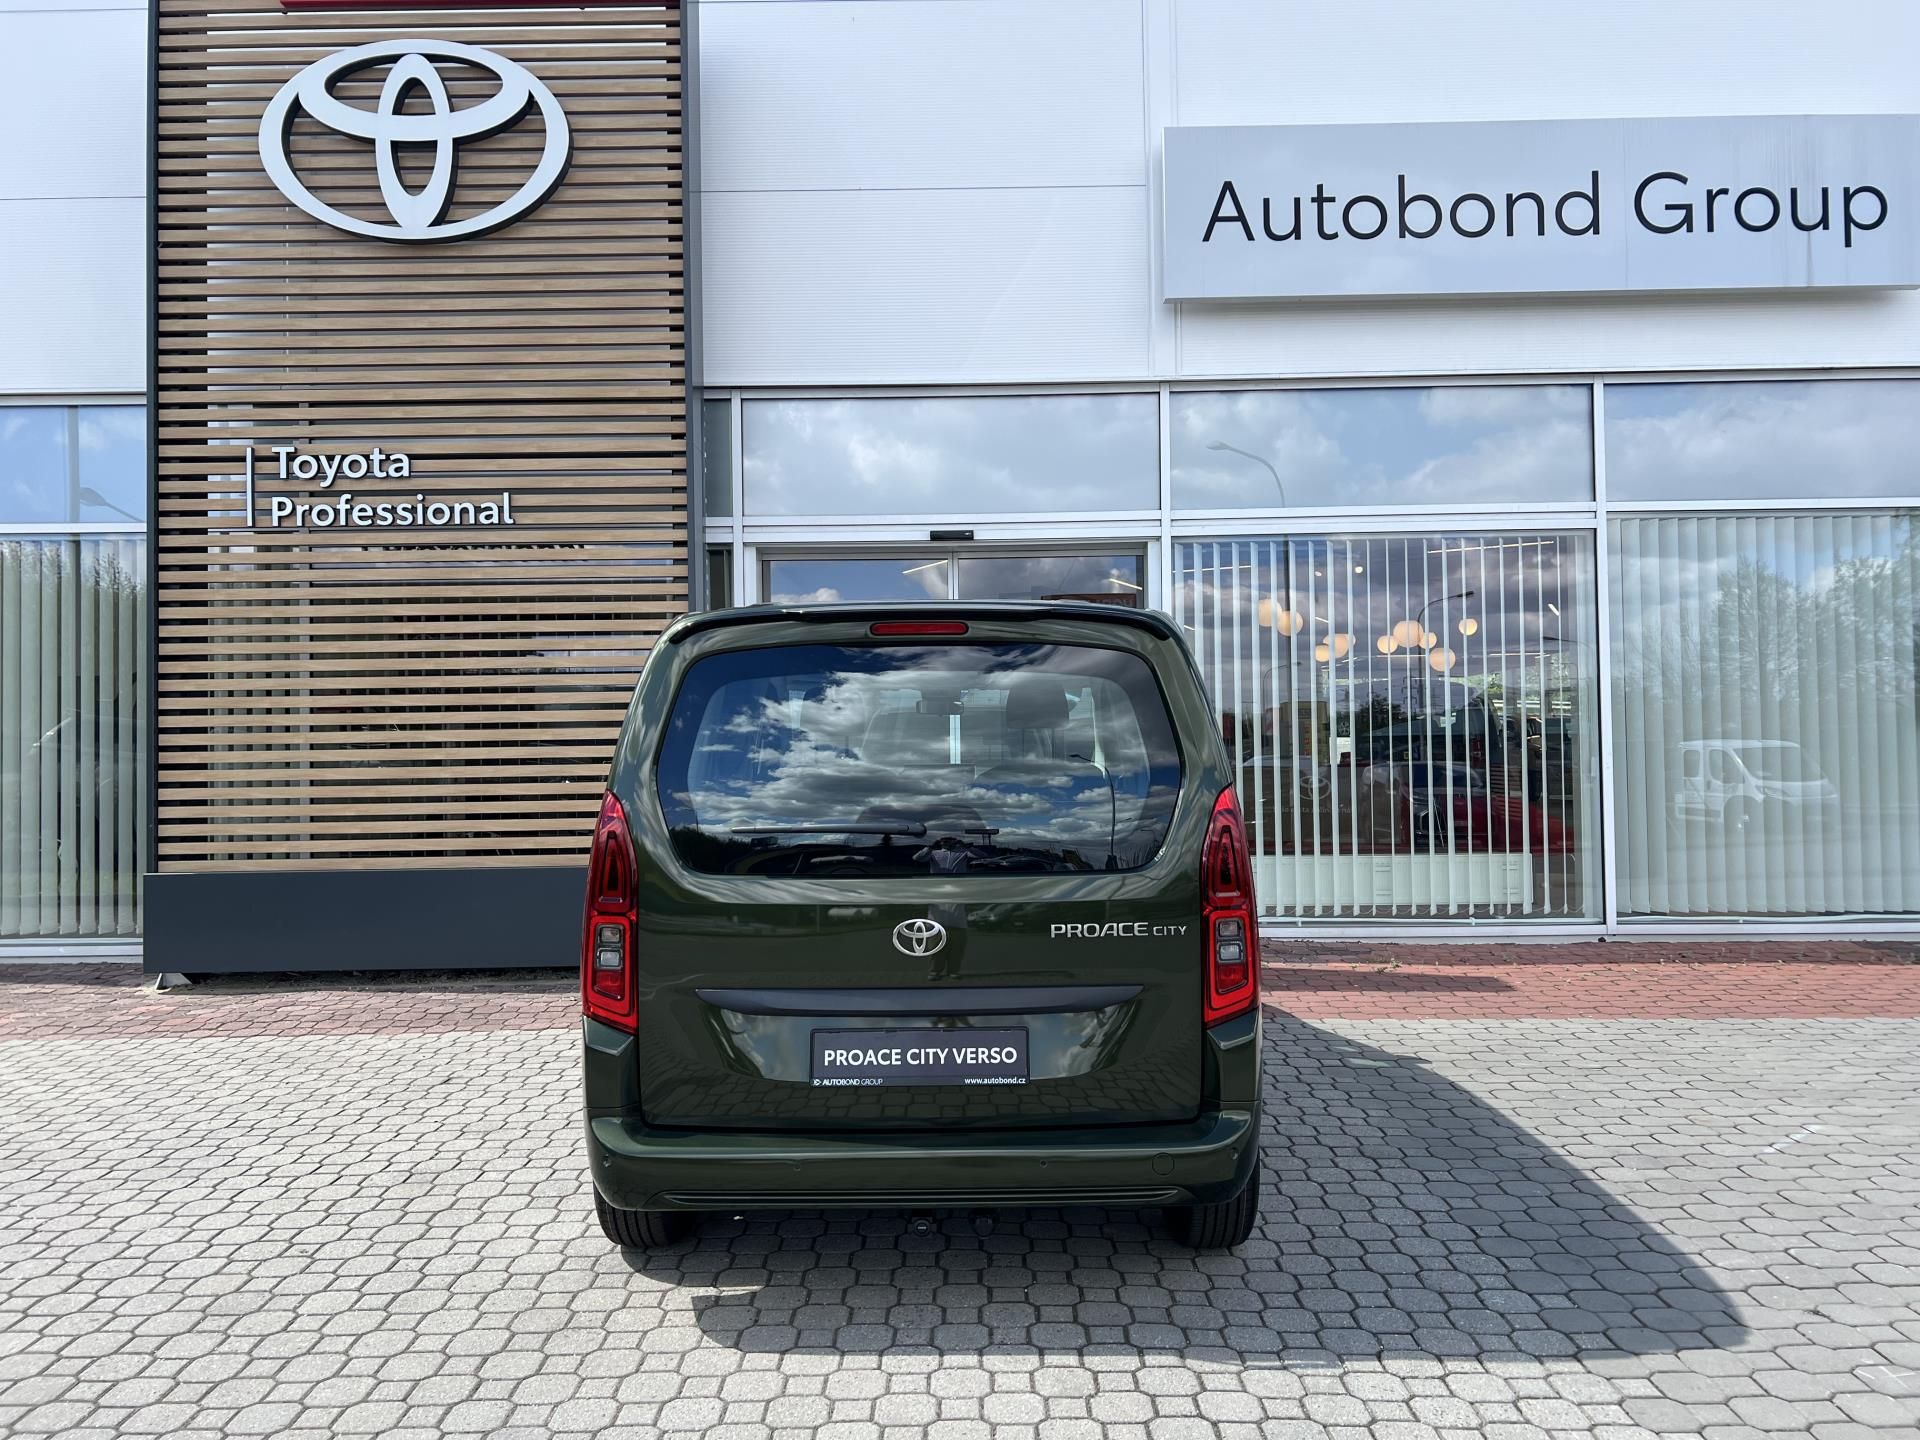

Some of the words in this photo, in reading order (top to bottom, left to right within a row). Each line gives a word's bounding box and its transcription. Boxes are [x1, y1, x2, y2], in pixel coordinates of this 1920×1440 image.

[1202, 169, 1600, 243] Autobond
[1633, 170, 1889, 248] Group
[271, 446, 411, 488] Toyota
[271, 492, 515, 527] Professional
[1050, 922, 1149, 938] PROACE
[1153, 925, 1187, 936] CITY
[824, 1049, 902, 1066] PROACE
[906, 1048, 949, 1065] CITY
[952, 1047, 1018, 1064] VERSO
[822, 1078, 860, 1086] AUTOBOND
[861, 1078, 883, 1086] GROUP
[964, 1076, 1026, 1085] www.autobond.cz
